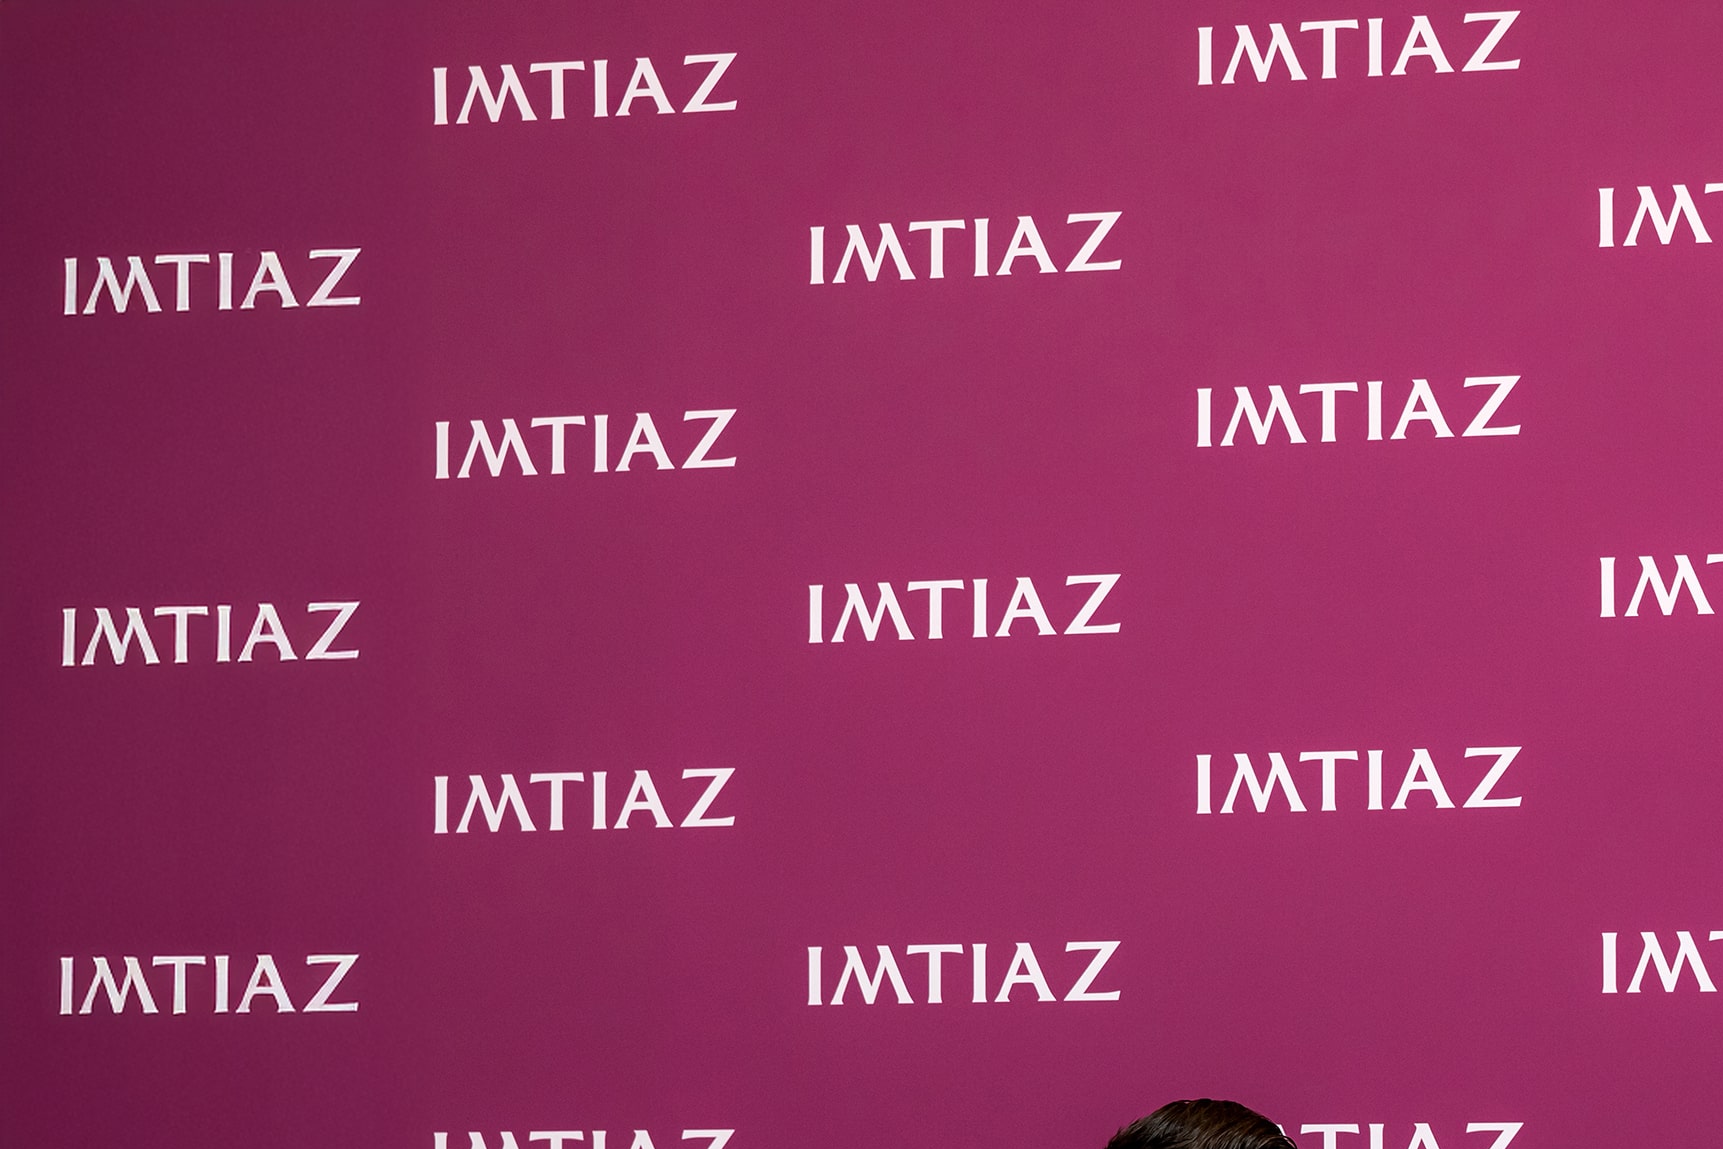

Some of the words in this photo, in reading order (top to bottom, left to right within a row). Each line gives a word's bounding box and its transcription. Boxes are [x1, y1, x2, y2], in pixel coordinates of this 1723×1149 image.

[1198, 11, 1520, 85] IMTIAZ
[433, 53, 737, 125] IMTIAZ
[64, 248, 361, 315] IMTIAZ
[810, 212, 1122, 284] IMTIAZ
[436, 409, 736, 479] IMTIAZ
[1197, 376, 1521, 447] IMTIAZ
[63, 602, 359, 666] IMTIAZ
[809, 574, 1121, 643] IMTIAZ
[435, 768, 735, 833] IMTIAZ
[1197, 747, 1522, 814] IMTIAZ
[60, 955, 359, 1014] IMTIAZ
[808, 941, 1120, 1005] IMTIAZ
